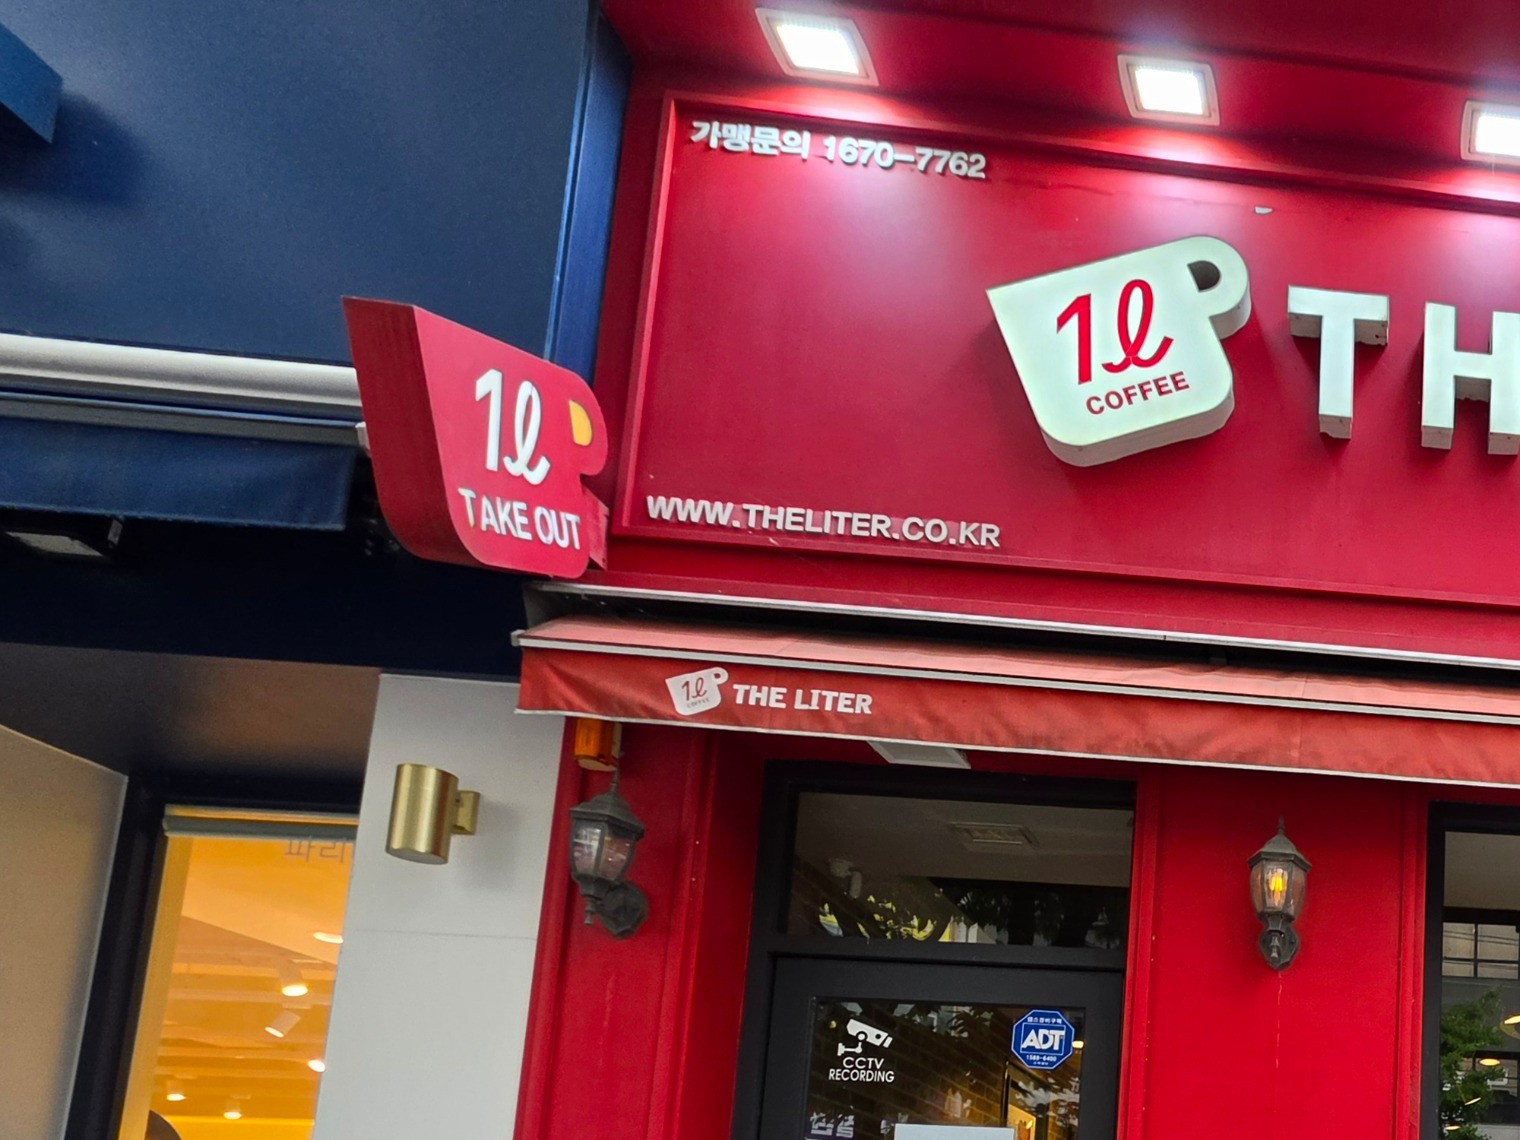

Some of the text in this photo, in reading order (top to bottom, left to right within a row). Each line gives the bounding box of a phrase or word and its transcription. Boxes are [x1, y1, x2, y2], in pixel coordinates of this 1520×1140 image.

[691, 121, 987, 179] 가맹문의 1670-7762
[1085, 370, 1190, 415] COFFEE
[457, 487, 581, 550] TAKE OUT
[646, 494, 1001, 548] WWW.THELITER.CO.KR
[733, 683, 873, 715] THE LITER
[1021, 1029, 1065, 1050] ADT
[828, 1069, 895, 1083] RECORDING
[842, 1057, 885, 1070] CCTV
